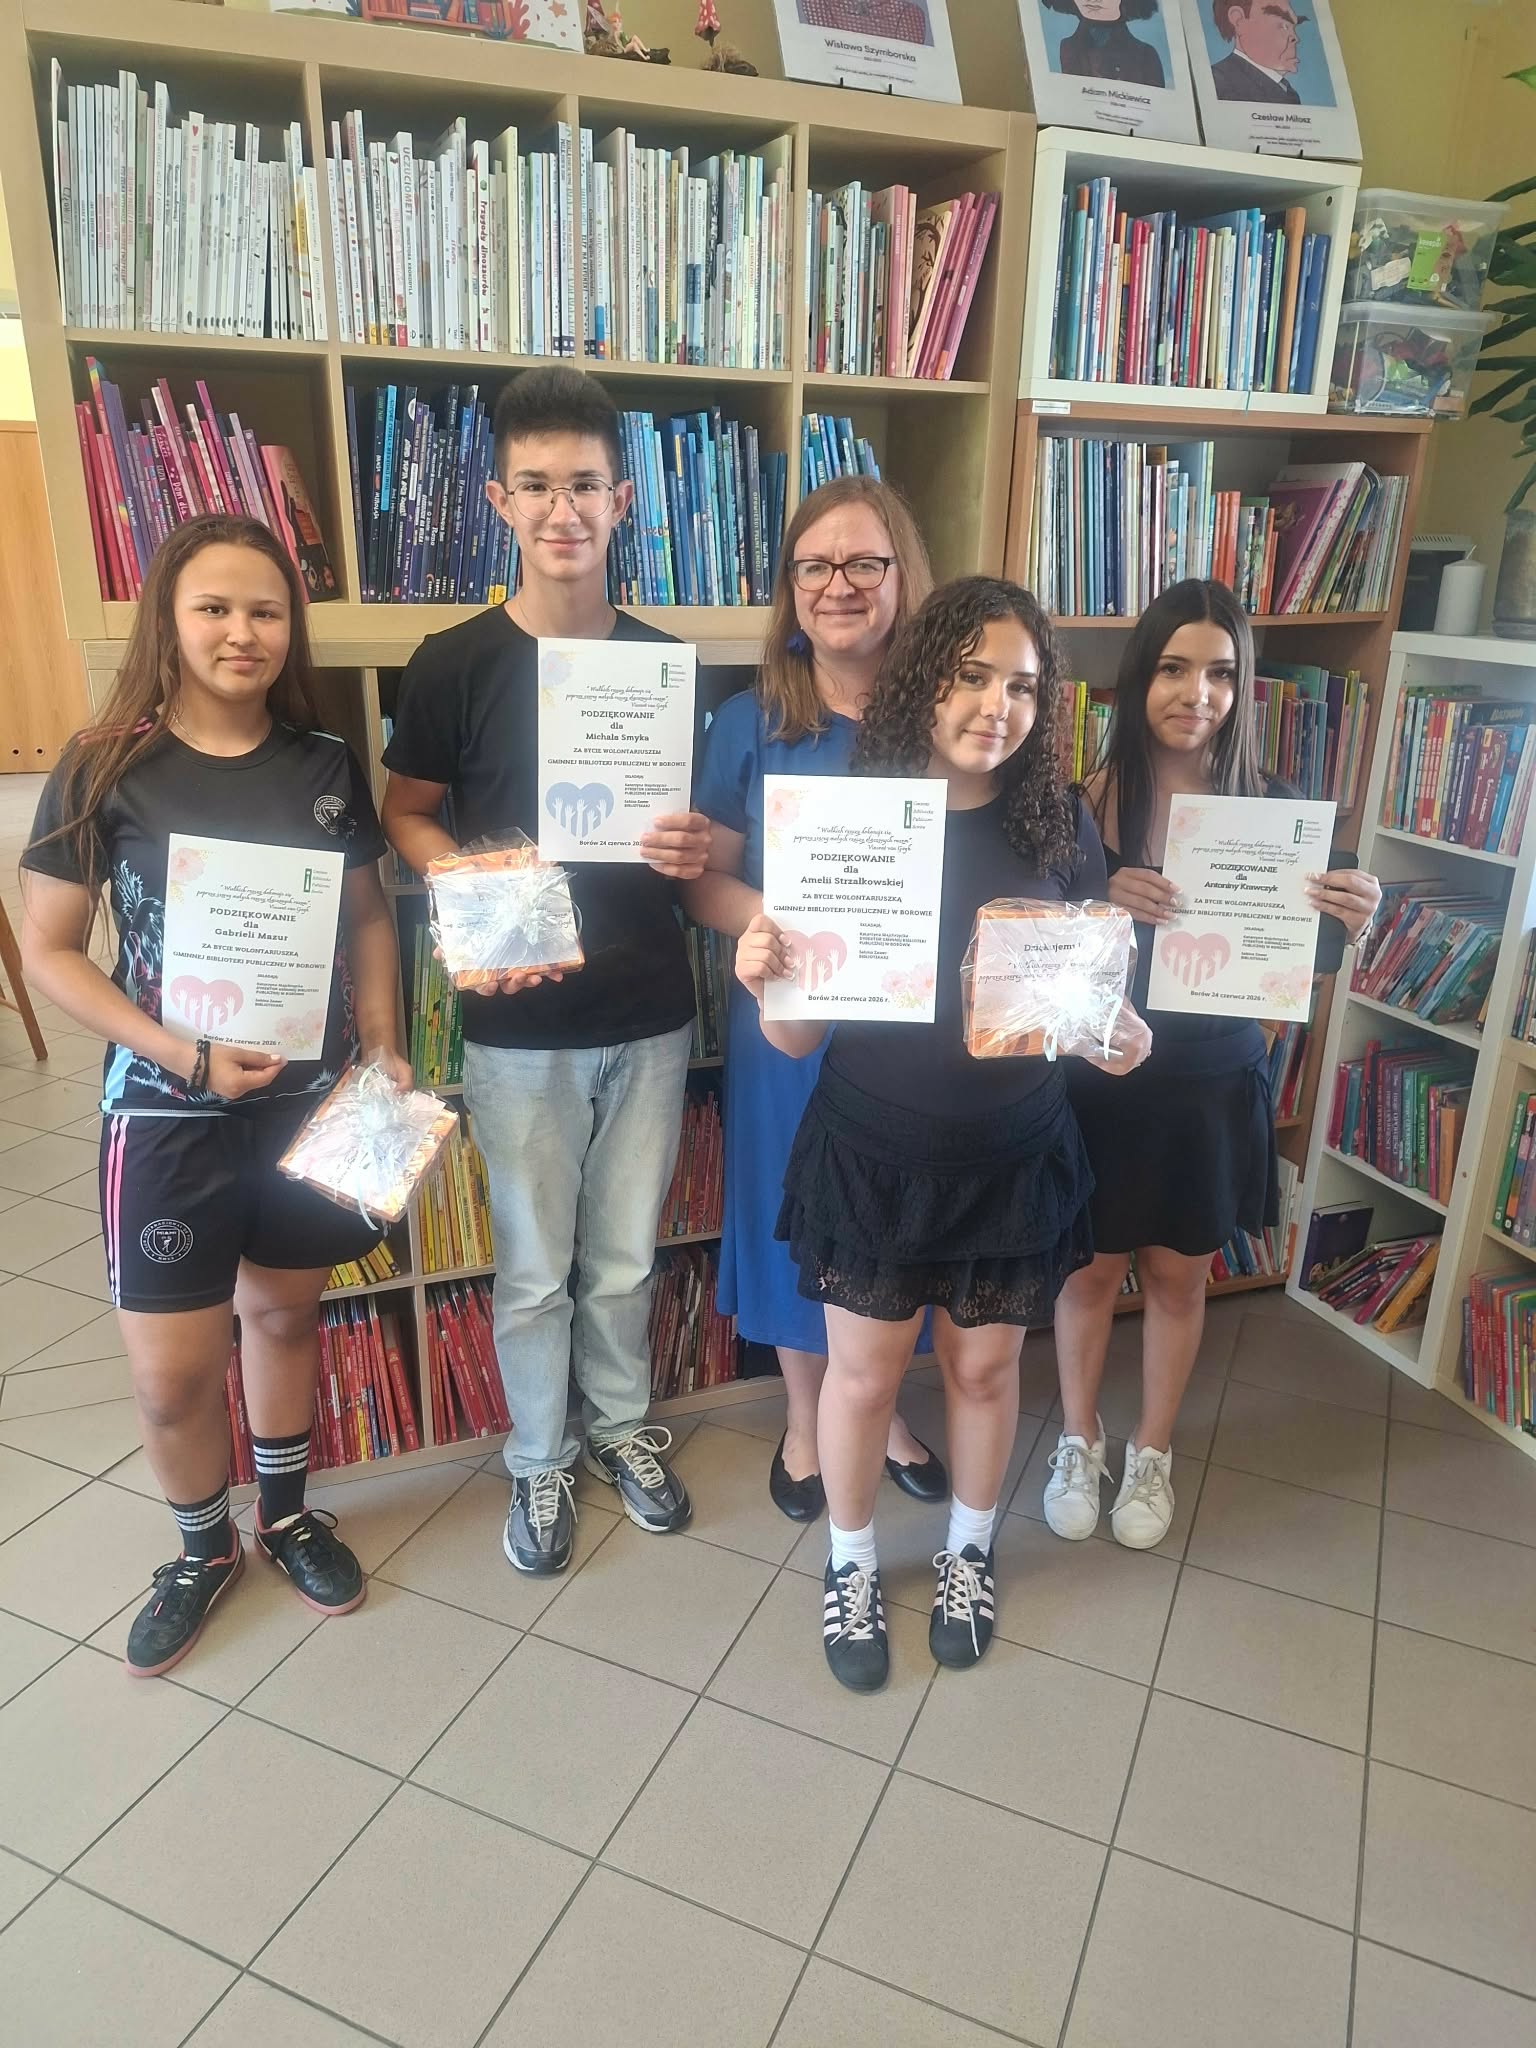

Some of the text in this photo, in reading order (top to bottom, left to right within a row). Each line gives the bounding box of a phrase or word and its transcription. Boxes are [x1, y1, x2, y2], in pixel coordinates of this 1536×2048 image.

[824, 39, 862, 51] Wisława
[864, 45, 916, 62] Szymborska
[1251, 113, 1284, 121] Czesław
[480, 200, 488, 242] Przygody
[581, 710, 655, 719] PODZIĘKOWANIE
[621, 734, 649, 742] Smyka
[811, 853, 895, 863] PODZIĘKOWANIE
[844, 865, 858, 873] dla
[1210, 863, 1277, 873] PODZIĘKOWANIE
[801, 876, 832, 884] Amelii
[1205, 881, 1278, 893] Antoniny Krawczyk
[836, 894, 902, 902] WOLONTARIUSZKĄ
[1225, 900, 1285, 909] WOLONTARIUSZKĄ
[210, 907, 296, 922] PODZIĘKOWANIE
[1198, 909, 1232, 917] BIBLIOTEKI
[1234, 912, 1273, 920] PUBLICZNEJ
[1282, 915, 1312, 923] BOROWIE
[243, 921, 259, 929] dla
[215, 928, 288, 942] Gabrieli Mazur
[235, 946, 299, 957] WOLONTARIUSZKĄ
[173, 951, 205, 961] GMINNEJ
[206, 956, 244, 965] BIBLIOTEKI
[246, 959, 287, 967] PUBLICZNEJ
